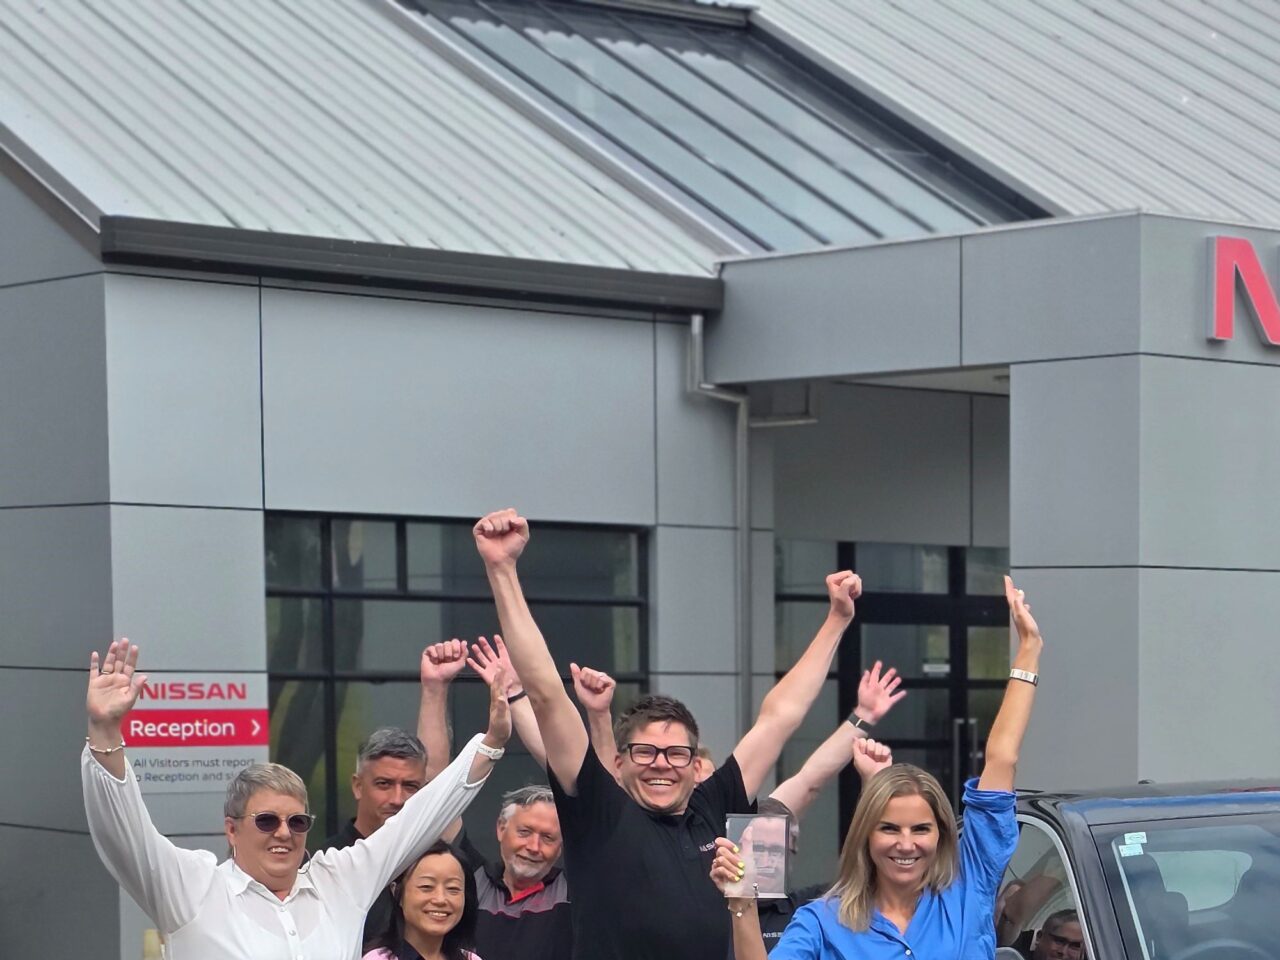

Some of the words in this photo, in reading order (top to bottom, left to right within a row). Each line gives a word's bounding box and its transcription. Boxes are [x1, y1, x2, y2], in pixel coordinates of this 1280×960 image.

[139, 682, 247, 700] NISSAN
[130, 719, 235, 741] Reception
[134, 758, 147, 768] All
[149, 758, 190, 768] Visitors
[192, 759, 220, 768] must
[145, 772, 199, 782] Reception
[201, 772, 223, 780] and
